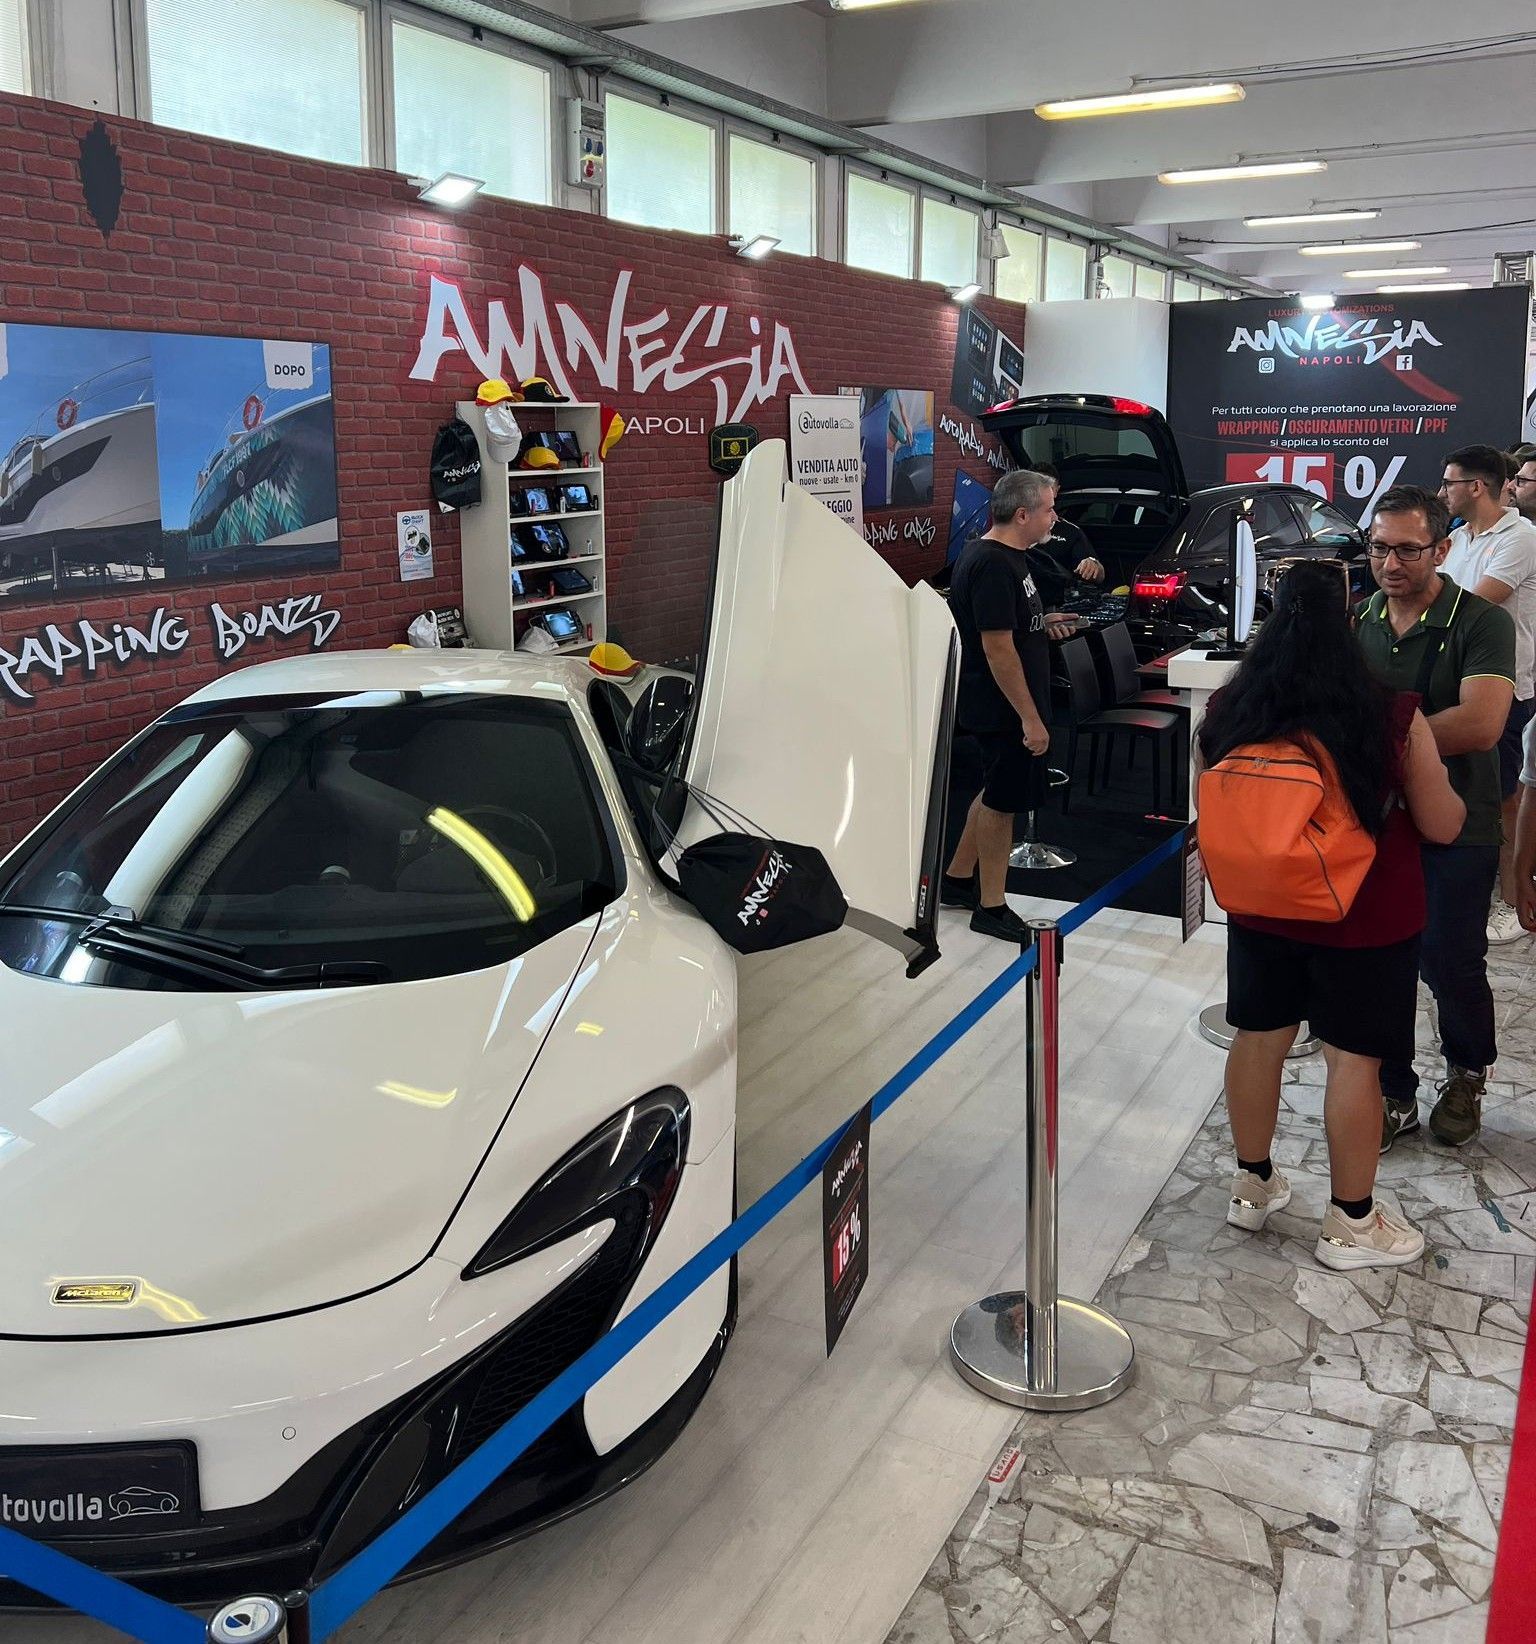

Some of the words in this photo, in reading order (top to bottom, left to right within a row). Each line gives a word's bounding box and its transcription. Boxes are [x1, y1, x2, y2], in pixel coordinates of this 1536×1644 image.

[1268, 308, 1303, 318] LUXUR
[1299, 355, 1361, 366] NAPOLI
[274, 364, 305, 376] DOPO
[1212, 406, 1228, 415] Per
[1231, 406, 1252, 414] tutti
[1255, 405, 1287, 414] coloro
[1290, 405, 1309, 413] che
[1311, 404, 1366, 415] prenotano
[1369, 404, 1390, 412] una
[1392, 403, 1457, 412] lavorazione
[625, 417, 704, 434] APOLI
[798, 411, 839, 434] autovolla
[1217, 420, 1280, 435] WRAPPING
[1288, 418, 1378, 435] OSCURAMENTO
[1380, 418, 1414, 434] VETRI
[1424, 418, 1448, 433] PPF
[1270, 438, 1278, 447] si
[1280, 438, 1318, 448] applica
[1320, 438, 1331, 446] lo
[1332, 438, 1370, 446] sconto
[1372, 437, 1389, 446] del
[797, 460, 834, 473] VENDITA
[837, 459, 859, 471] AUTO
[800, 477, 818, 485] nuove
[823, 476, 839, 484] usate
[2, 1493, 103, 1523] tovolla
